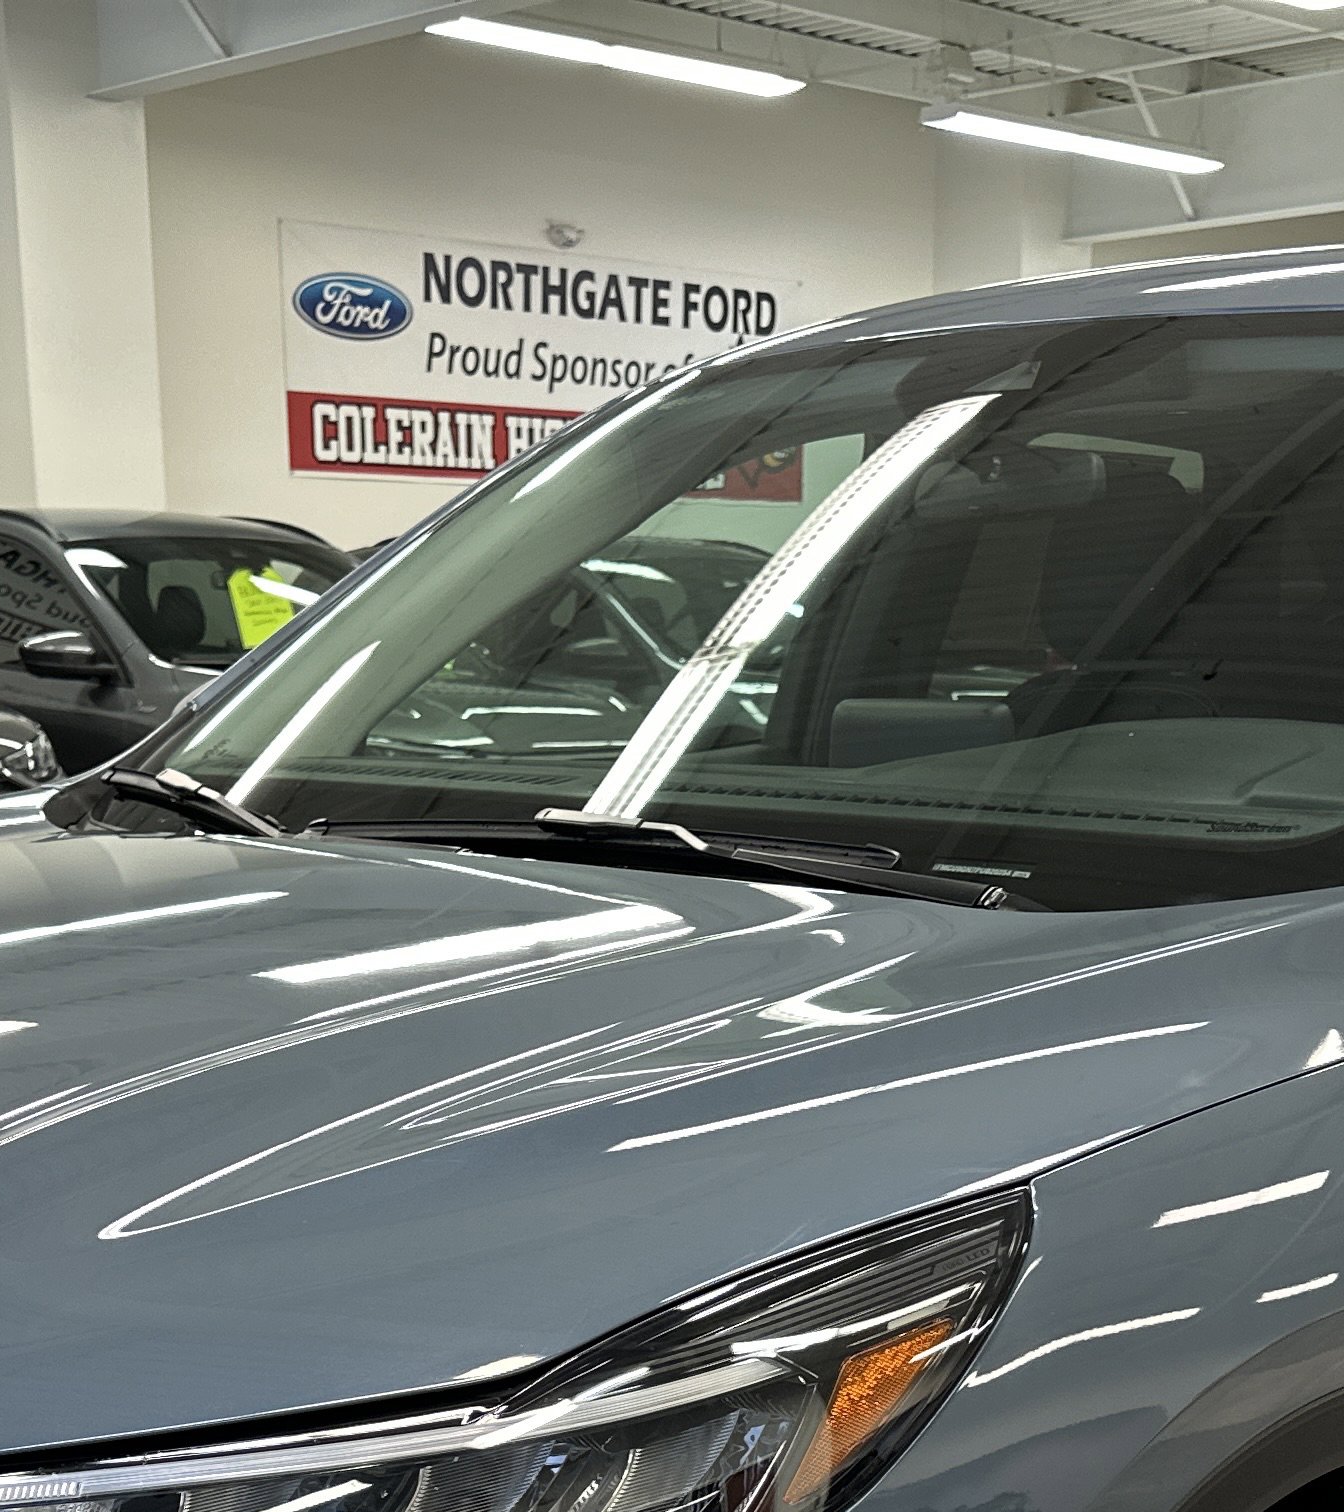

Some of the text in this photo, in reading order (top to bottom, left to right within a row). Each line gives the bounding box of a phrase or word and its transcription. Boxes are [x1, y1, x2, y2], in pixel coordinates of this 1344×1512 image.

[314, 282, 392, 332] Ford
[422, 251, 779, 338] NORTHGATE FORD
[426, 332, 655, 393] Proud Sponsor
[312, 401, 497, 470] COLERAIN
